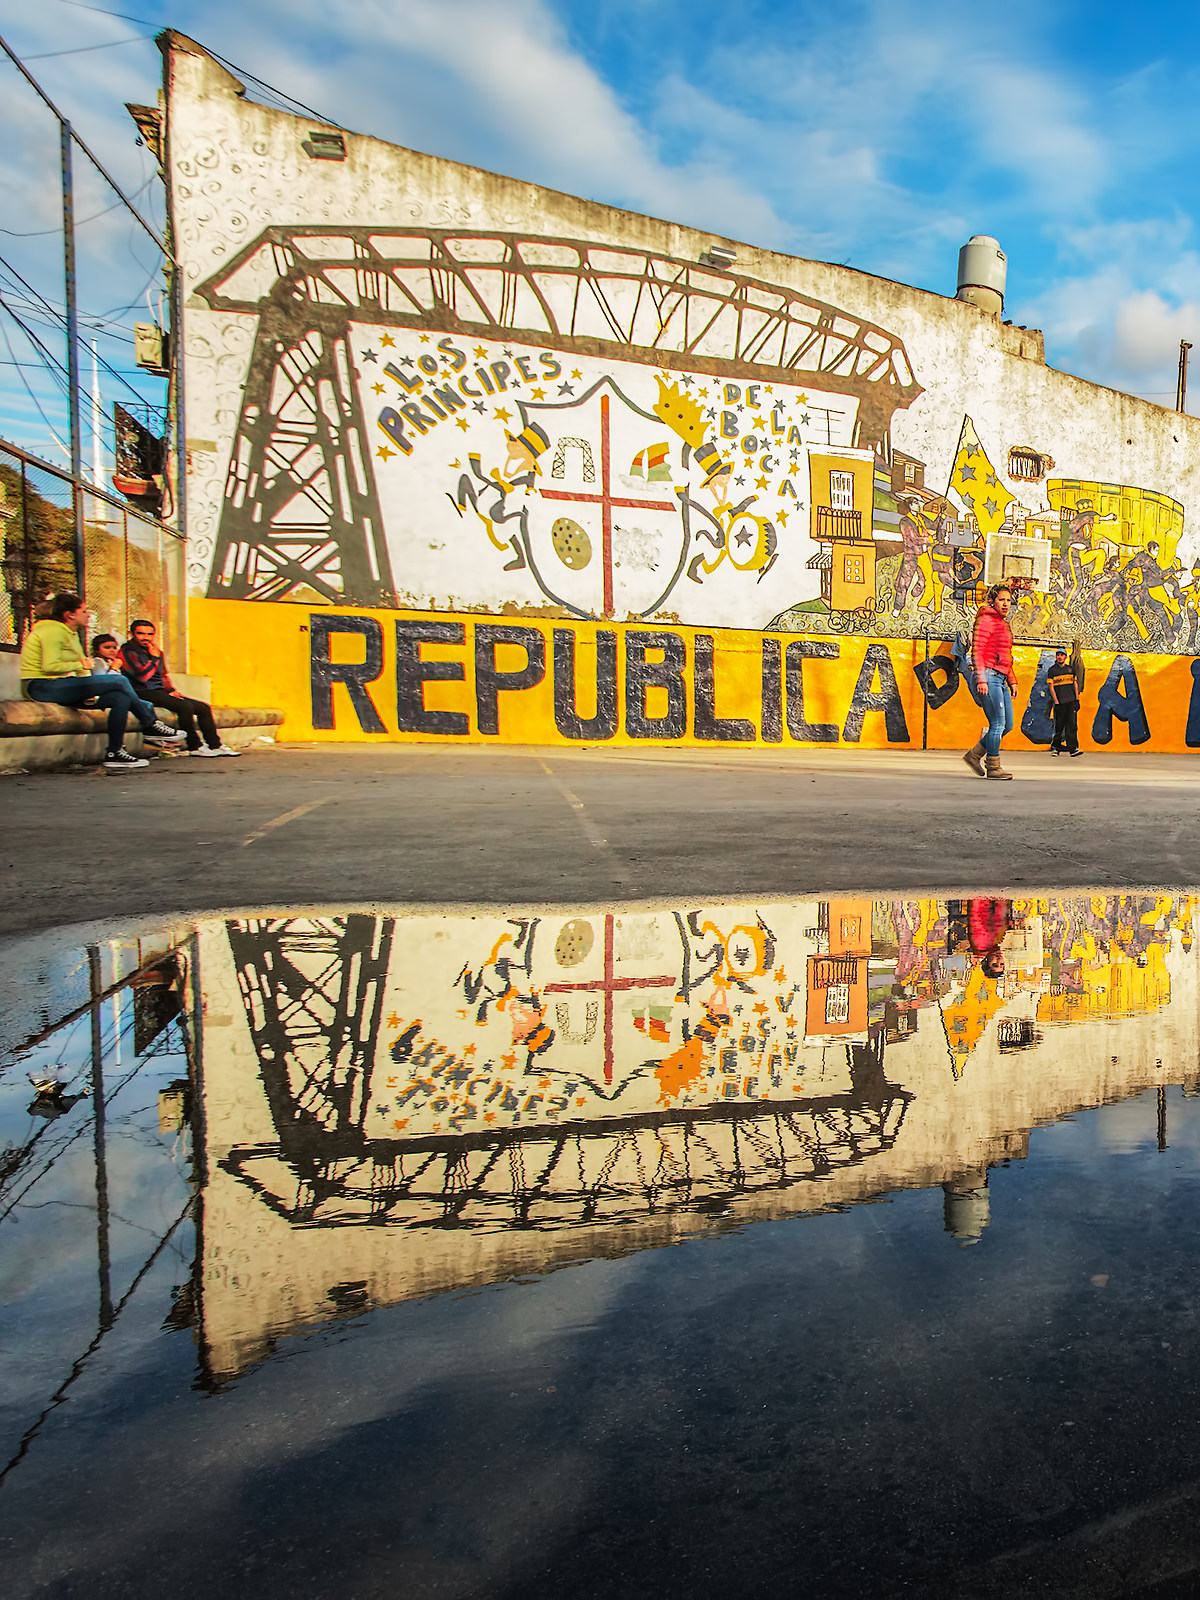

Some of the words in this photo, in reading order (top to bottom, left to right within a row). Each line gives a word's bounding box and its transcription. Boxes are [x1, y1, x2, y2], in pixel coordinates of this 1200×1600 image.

[377, 352, 562, 456] PRINCIPES
[383, 337, 467, 394] LOS
[720, 410, 797, 499] BOCA
[723, 383, 761, 410] DE
[770, 409, 802, 446] LA
[310, 613, 911, 742] REPUBLICA
